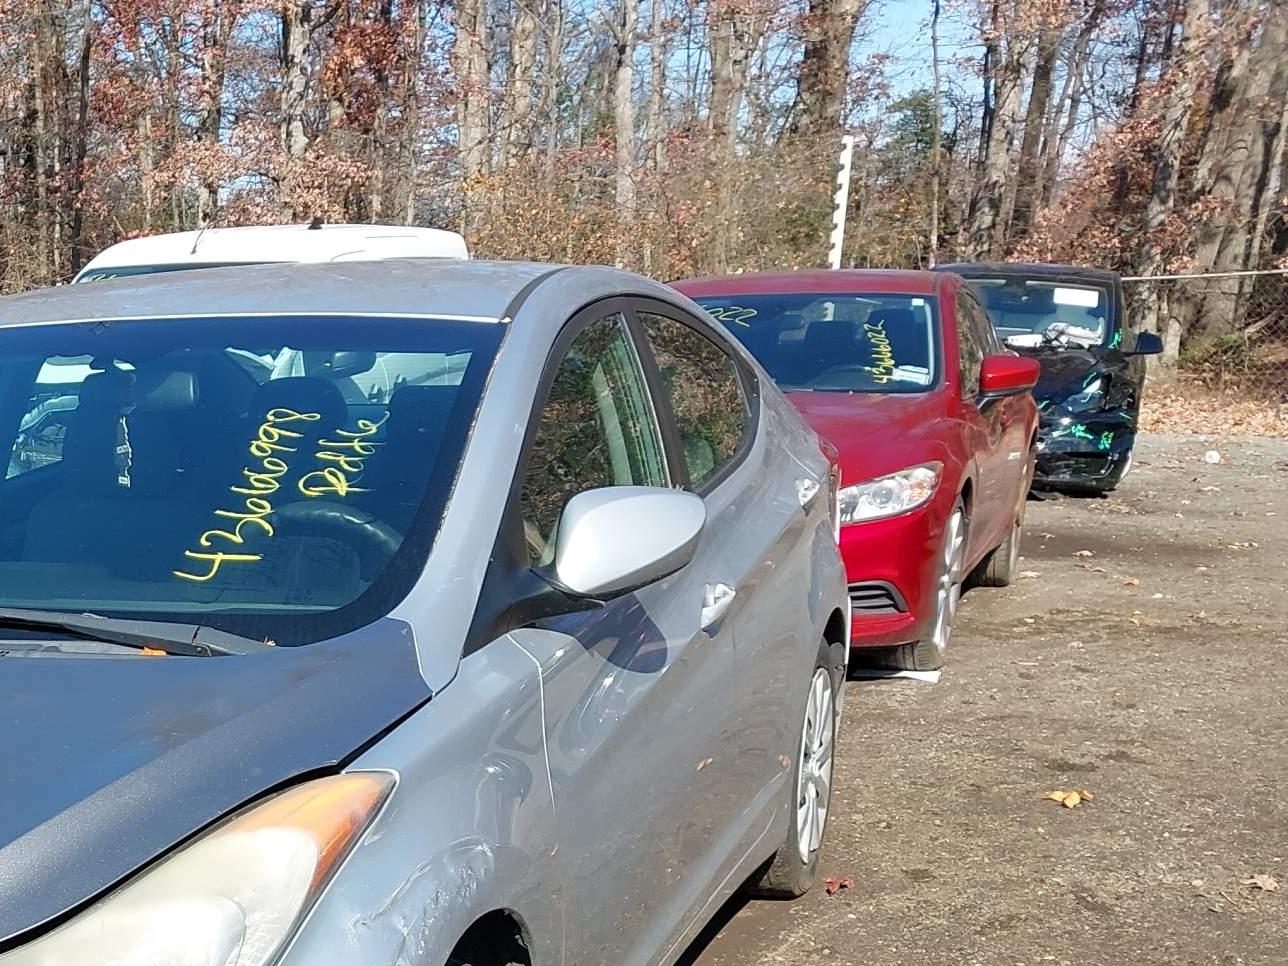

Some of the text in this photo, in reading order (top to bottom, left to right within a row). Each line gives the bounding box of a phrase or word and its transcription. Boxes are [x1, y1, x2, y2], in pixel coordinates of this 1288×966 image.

[700, 304, 758, 328] 022
[863, 319, 896, 384] 43666022
[172, 407, 322, 581] 43666998
